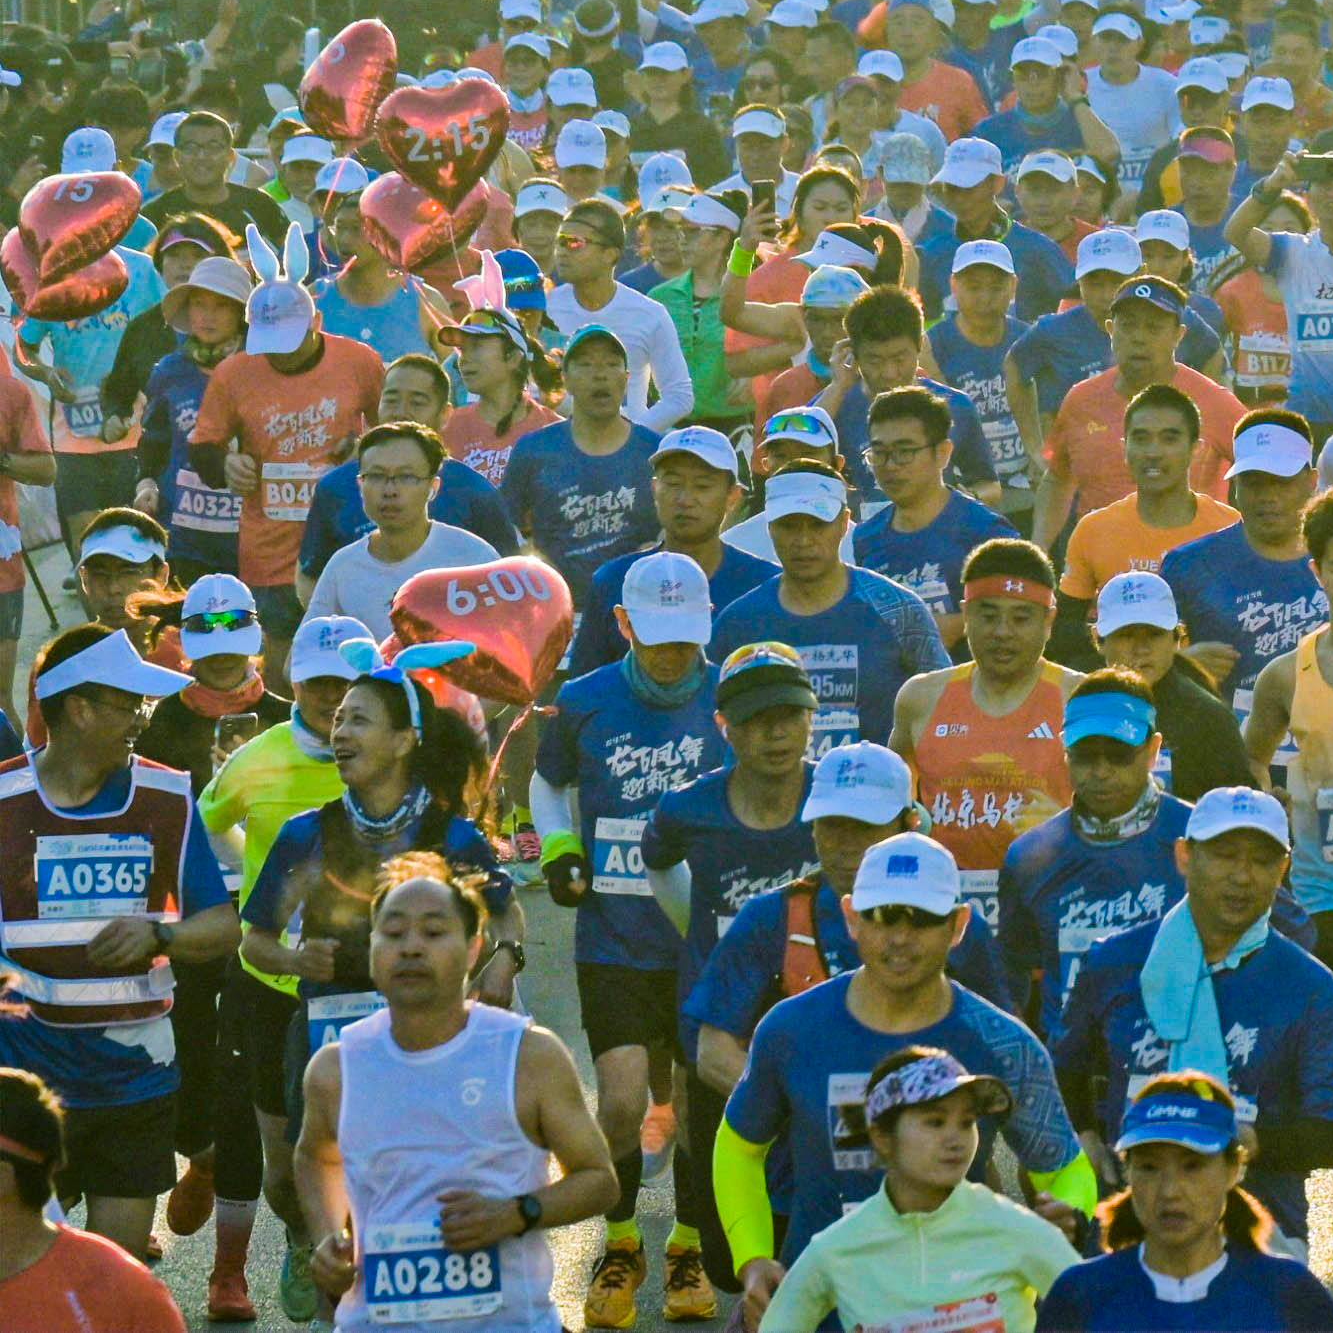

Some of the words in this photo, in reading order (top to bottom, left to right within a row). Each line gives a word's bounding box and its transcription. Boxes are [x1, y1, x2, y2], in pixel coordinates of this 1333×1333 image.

[407, 115, 490, 163] 2:15
[267, 483, 317, 505] B04
[445, 568, 550, 614] 6:00
[47, 861, 147, 897] A0365
[374, 1253, 493, 1296] A0288
